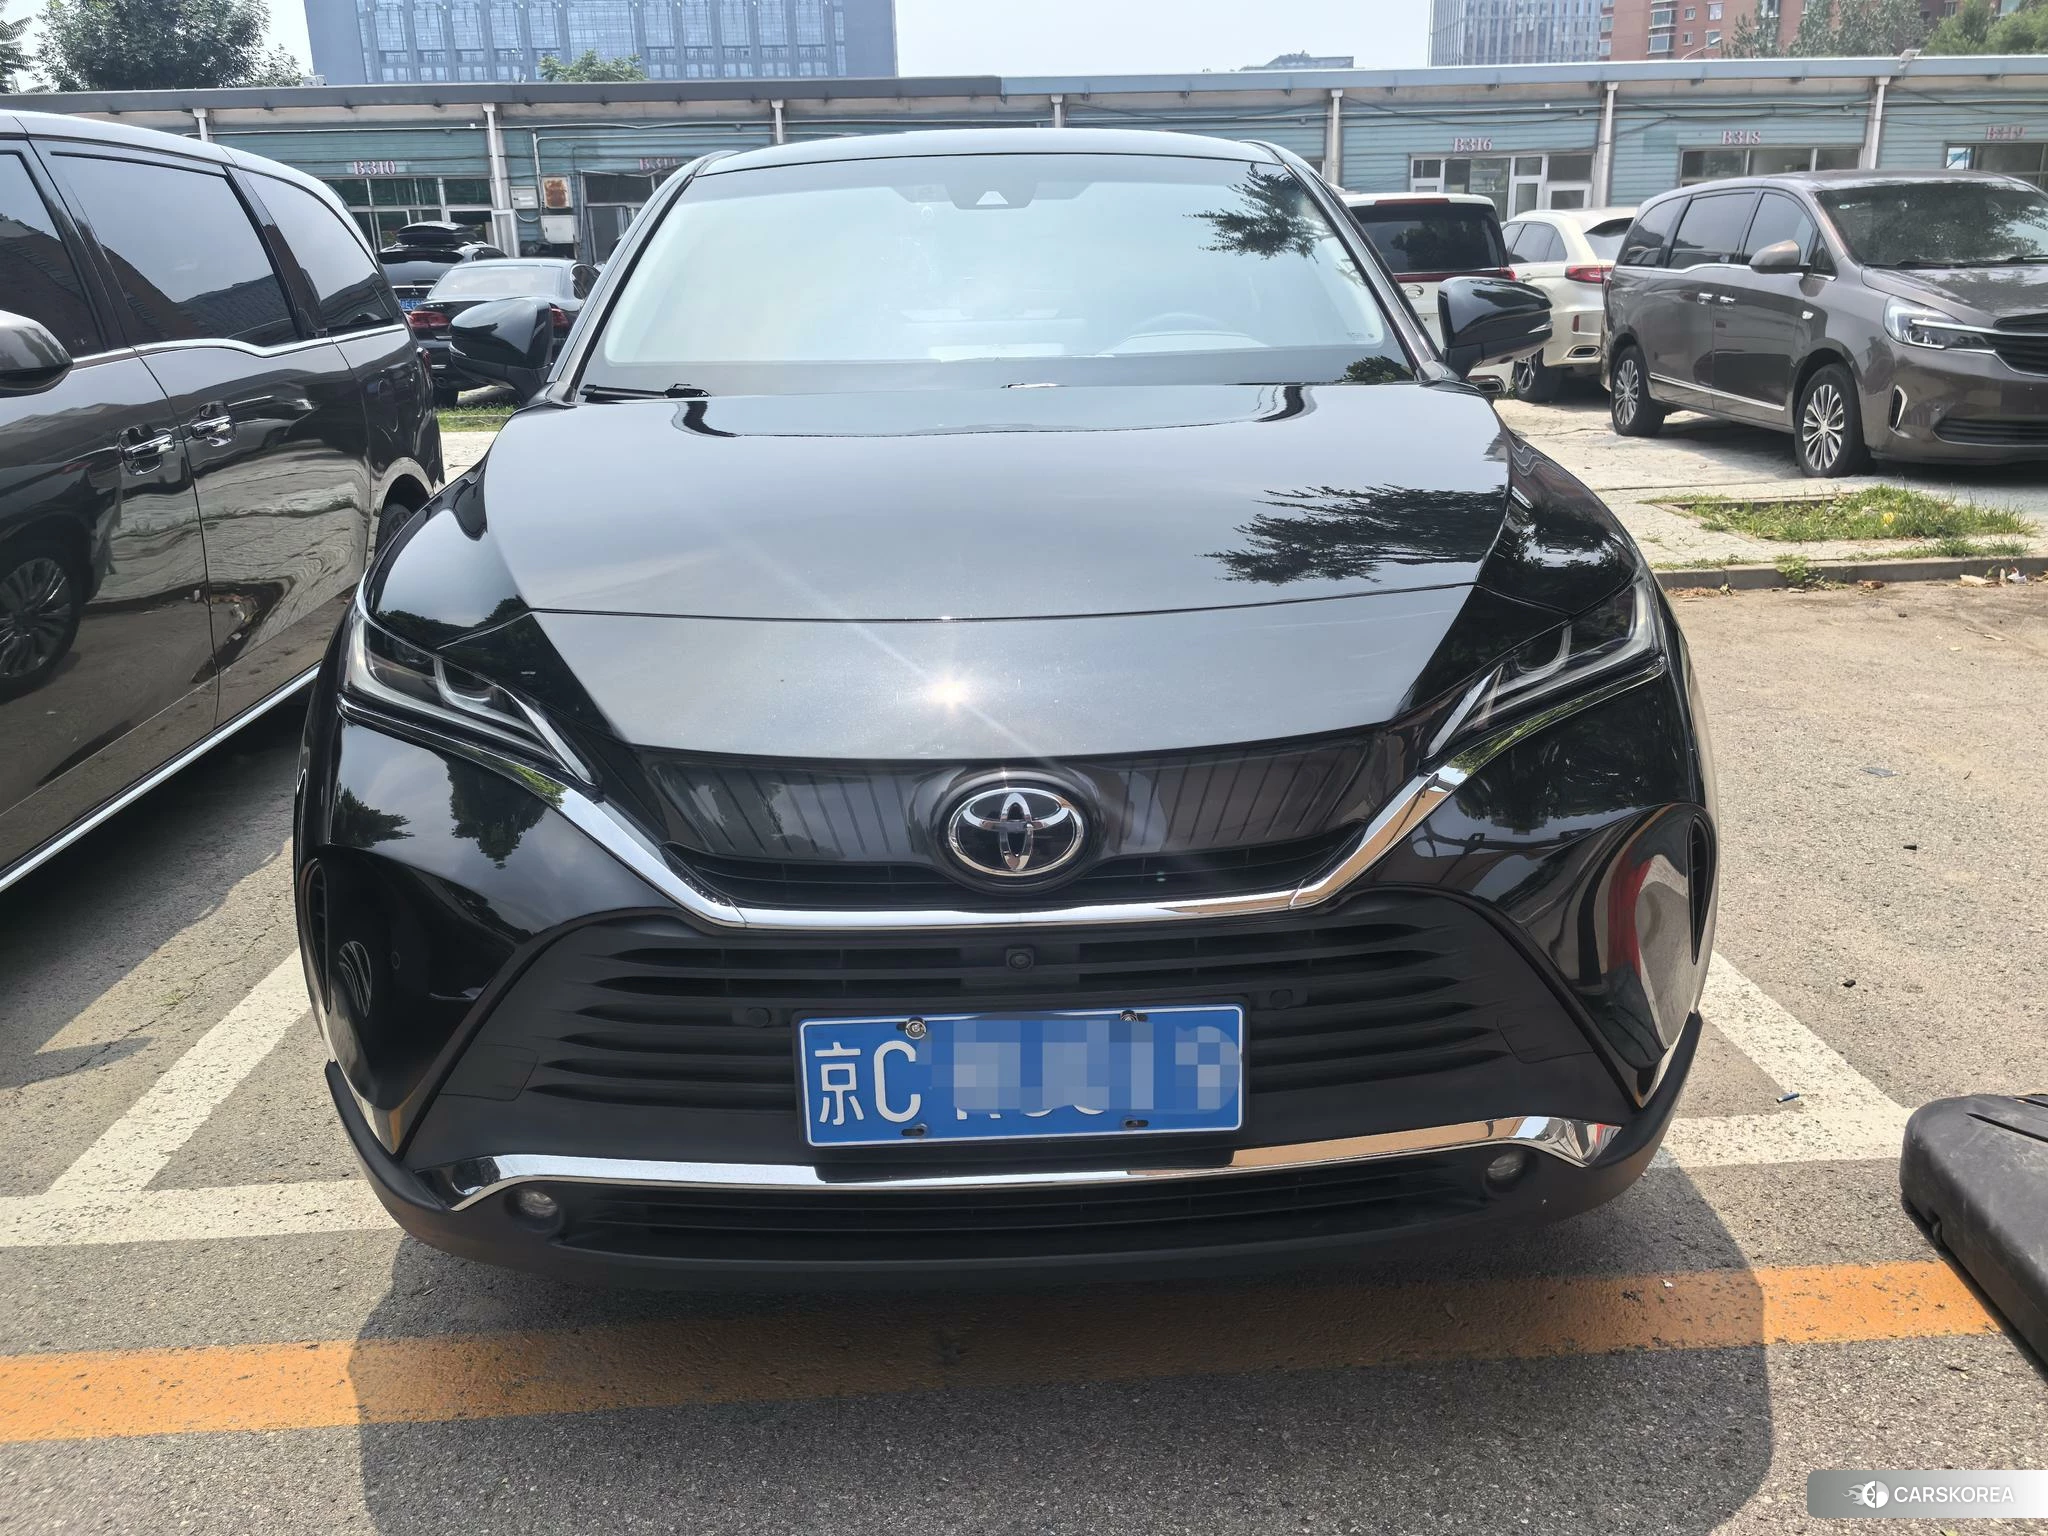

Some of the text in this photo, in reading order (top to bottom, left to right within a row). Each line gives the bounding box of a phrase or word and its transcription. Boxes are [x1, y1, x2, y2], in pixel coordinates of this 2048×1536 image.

[1453, 137, 1493, 152] B316
[1721, 129, 1761, 145] B318
[353, 160, 396, 175] B310
